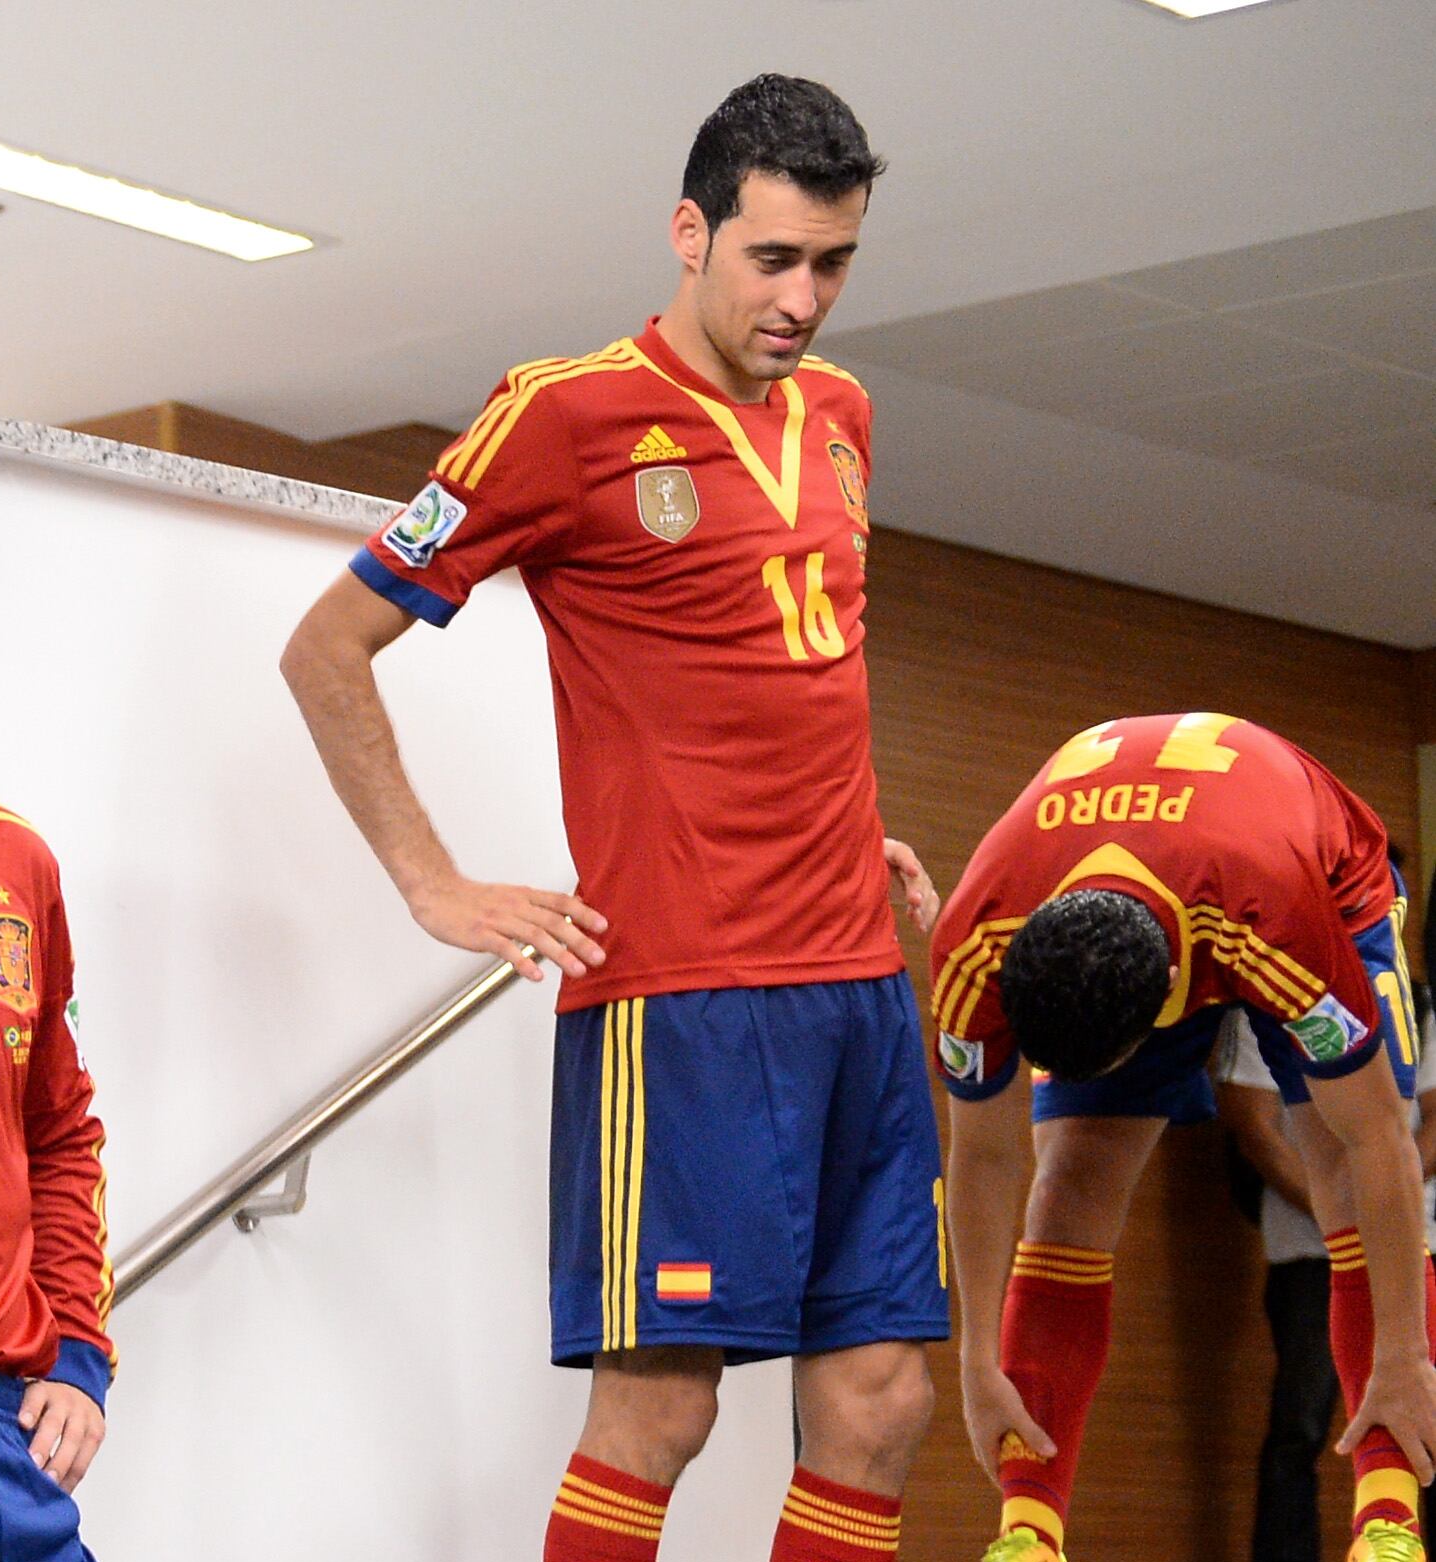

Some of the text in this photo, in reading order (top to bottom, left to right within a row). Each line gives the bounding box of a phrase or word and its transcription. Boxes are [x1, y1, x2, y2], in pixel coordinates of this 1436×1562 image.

[630, 446, 688, 463] adidas
[761, 551, 846, 661] 16
[1037, 783, 1194, 830] PEDRO
